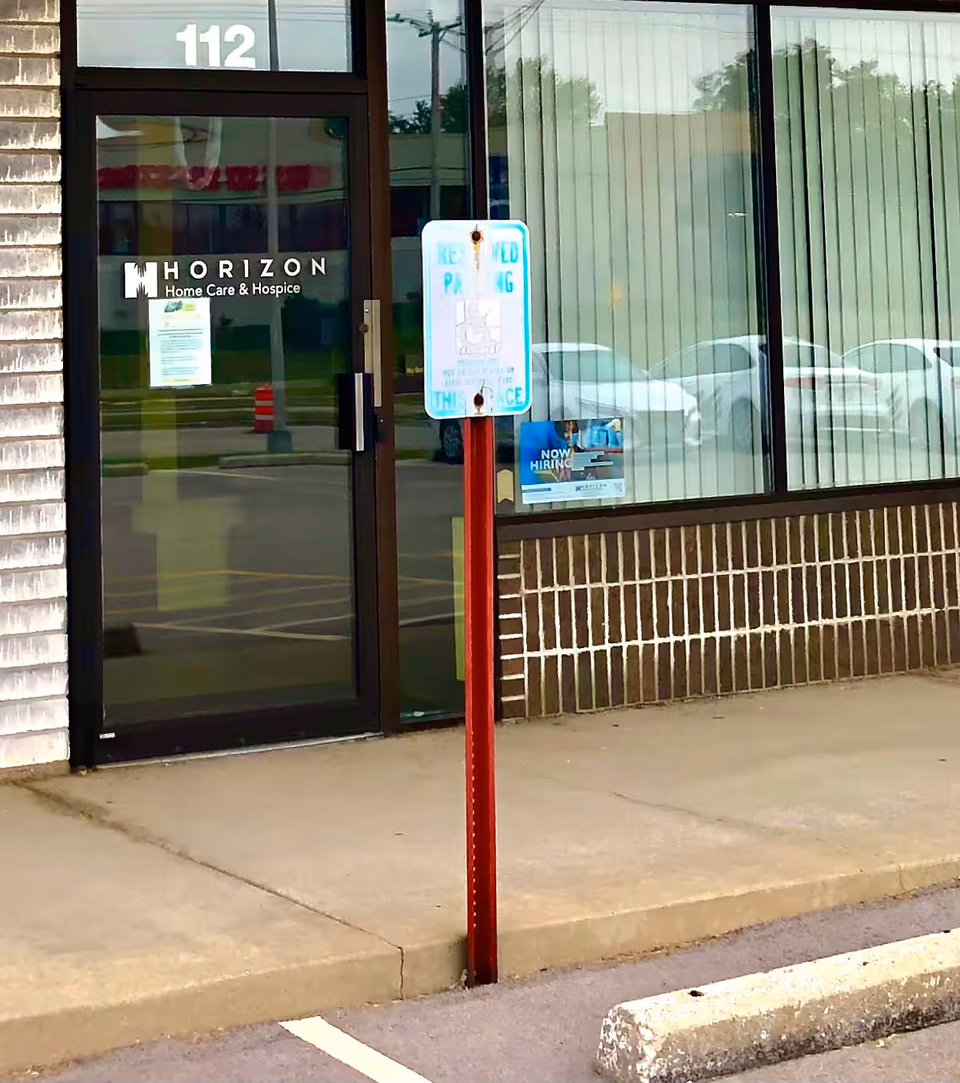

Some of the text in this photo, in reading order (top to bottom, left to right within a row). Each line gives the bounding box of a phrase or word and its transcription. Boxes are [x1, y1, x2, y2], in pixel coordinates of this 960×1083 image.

[176, 23, 256, 68] 112
[164, 257, 326, 280] HORIZON
[165, 282, 301, 298] Home Care & Hospice
[541, 448, 571, 459] NOW
[530, 458, 573, 471] HIRING
